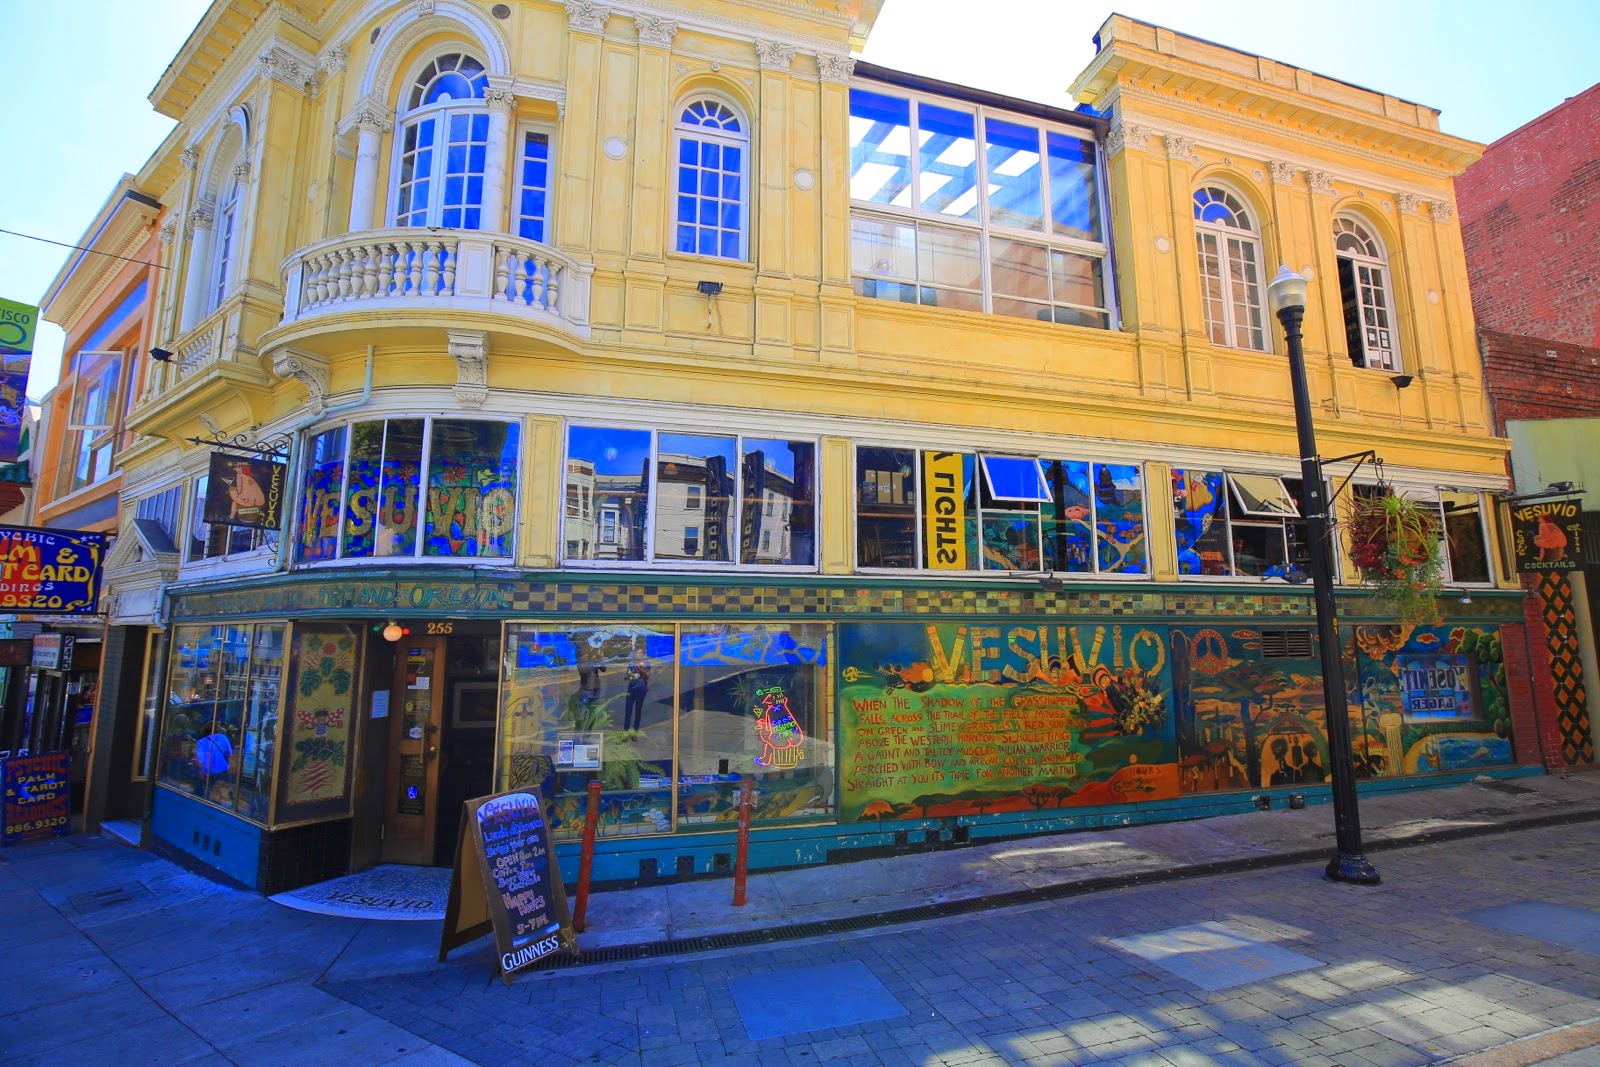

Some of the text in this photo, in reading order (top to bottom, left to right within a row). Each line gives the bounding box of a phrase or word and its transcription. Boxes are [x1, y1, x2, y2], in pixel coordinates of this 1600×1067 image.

[0, 308, 30, 325] ISCO
[266, 465, 281, 528] VESUVIO
[304, 485, 515, 547] VESUVIO
[1514, 503, 1577, 522] VESUVIO
[56, 548, 79, 564] &
[22, 564, 90, 583] CARD
[1525, 561, 1576, 570] COCKTAILS
[427, 622, 453, 635] 255
[62, 637, 74, 670] 245
[925, 625, 1165, 685] VESUVIO
[852, 696, 1077, 712] WHEN THE SHADOW OF THE GRASSHOPPER
[860, 713, 886, 725] FALLS
[891, 713, 922, 723] ACROSS
[927, 711, 941, 720] THE
[944, 710, 966, 720] TRAIL
[983, 710, 998, 719] THE
[1003, 710, 1028, 719] FIELD
[1034, 710, 1066, 719] MOUSE
[857, 728, 873, 736] ON
[878, 727, 907, 736] GREEN
[965, 722, 995, 731] GRASS
[1000, 721, 1011, 730] AS
[1016, 721, 1020, 730] A
[1025, 721, 1044, 730] RED
[1049, 720, 1064, 729] SUN
[857, 738, 890, 748] ABOVE
[893, 735, 907, 745] THE
[910, 735, 953, 746] WESTERN
[958, 734, 995, 742] HORIZON
[854, 752, 864, 763] A
[868, 748, 901, 760] GAUNT
[904, 748, 921, 757] AND
[957, 746, 996, 756] MUSCLED
[1031, 742, 1070, 752] WARRIOR
[854, 762, 899, 776] PERCHED
[901, 759, 921, 770] WITH
[924, 758, 945, 768] BOW
[949, 758, 966, 767] AND
[969, 756, 998, 766] ARROW
[1003, 756, 1037, 766] COCKED
[1042, 754, 1055, 762] AND
[1130, 766, 1160, 776] HOURS
[18, 773, 56, 785] PALM
[897, 776, 907, 785] AT
[911, 774, 928, 784] YOU
[976, 769, 993, 778] FOR
[997, 768, 1034, 778] ANOTHER
[24, 781, 66, 793] TAROT
[18, 793, 55, 804] CARD
[496, 852, 518, 869] OPEN
[326, 891, 433, 908] VESUVIO
[502, 890, 535, 909] Happy
[502, 935, 559, 970] GUINNESS
